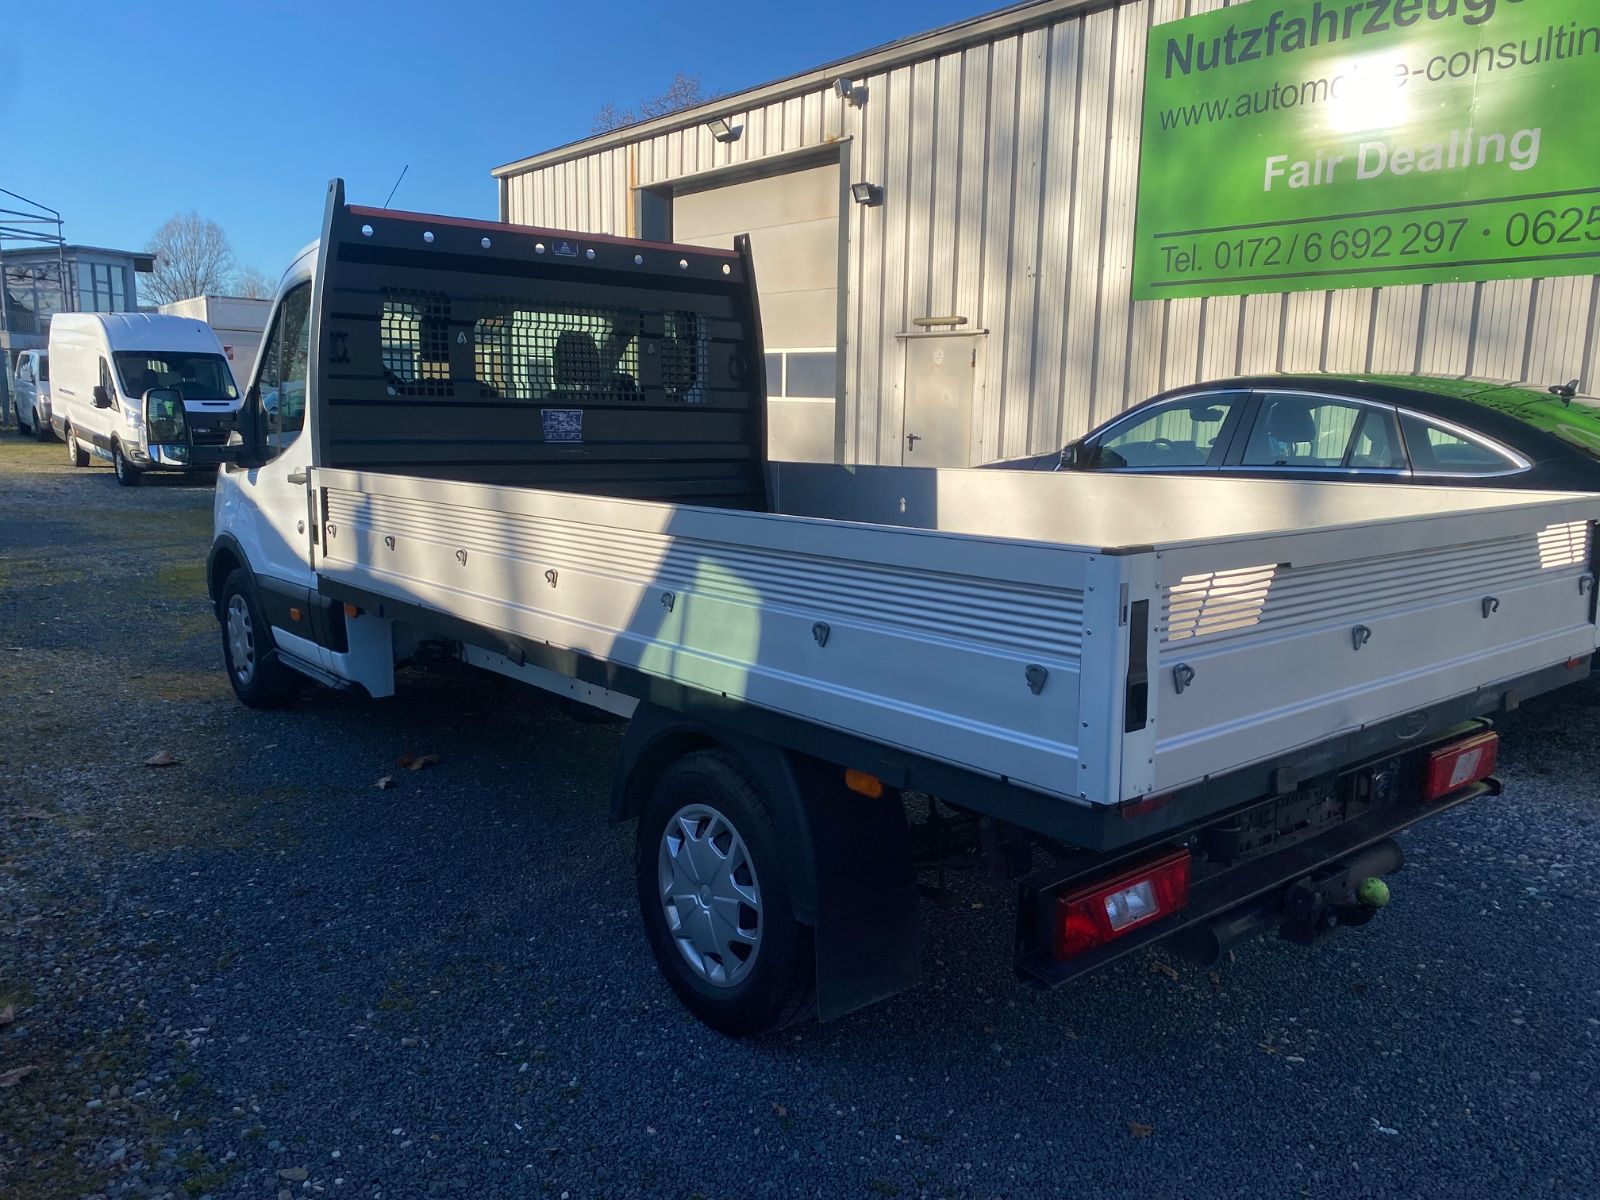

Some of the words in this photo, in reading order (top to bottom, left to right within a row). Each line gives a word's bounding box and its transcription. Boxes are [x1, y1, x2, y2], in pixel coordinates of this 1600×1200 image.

[1164, 0, 1526, 79] Nutzfahrzeug
[1263, 149, 1344, 192] Fair
[1355, 126, 1542, 180] Dealing
[1160, 244, 1203, 273] Tel.
